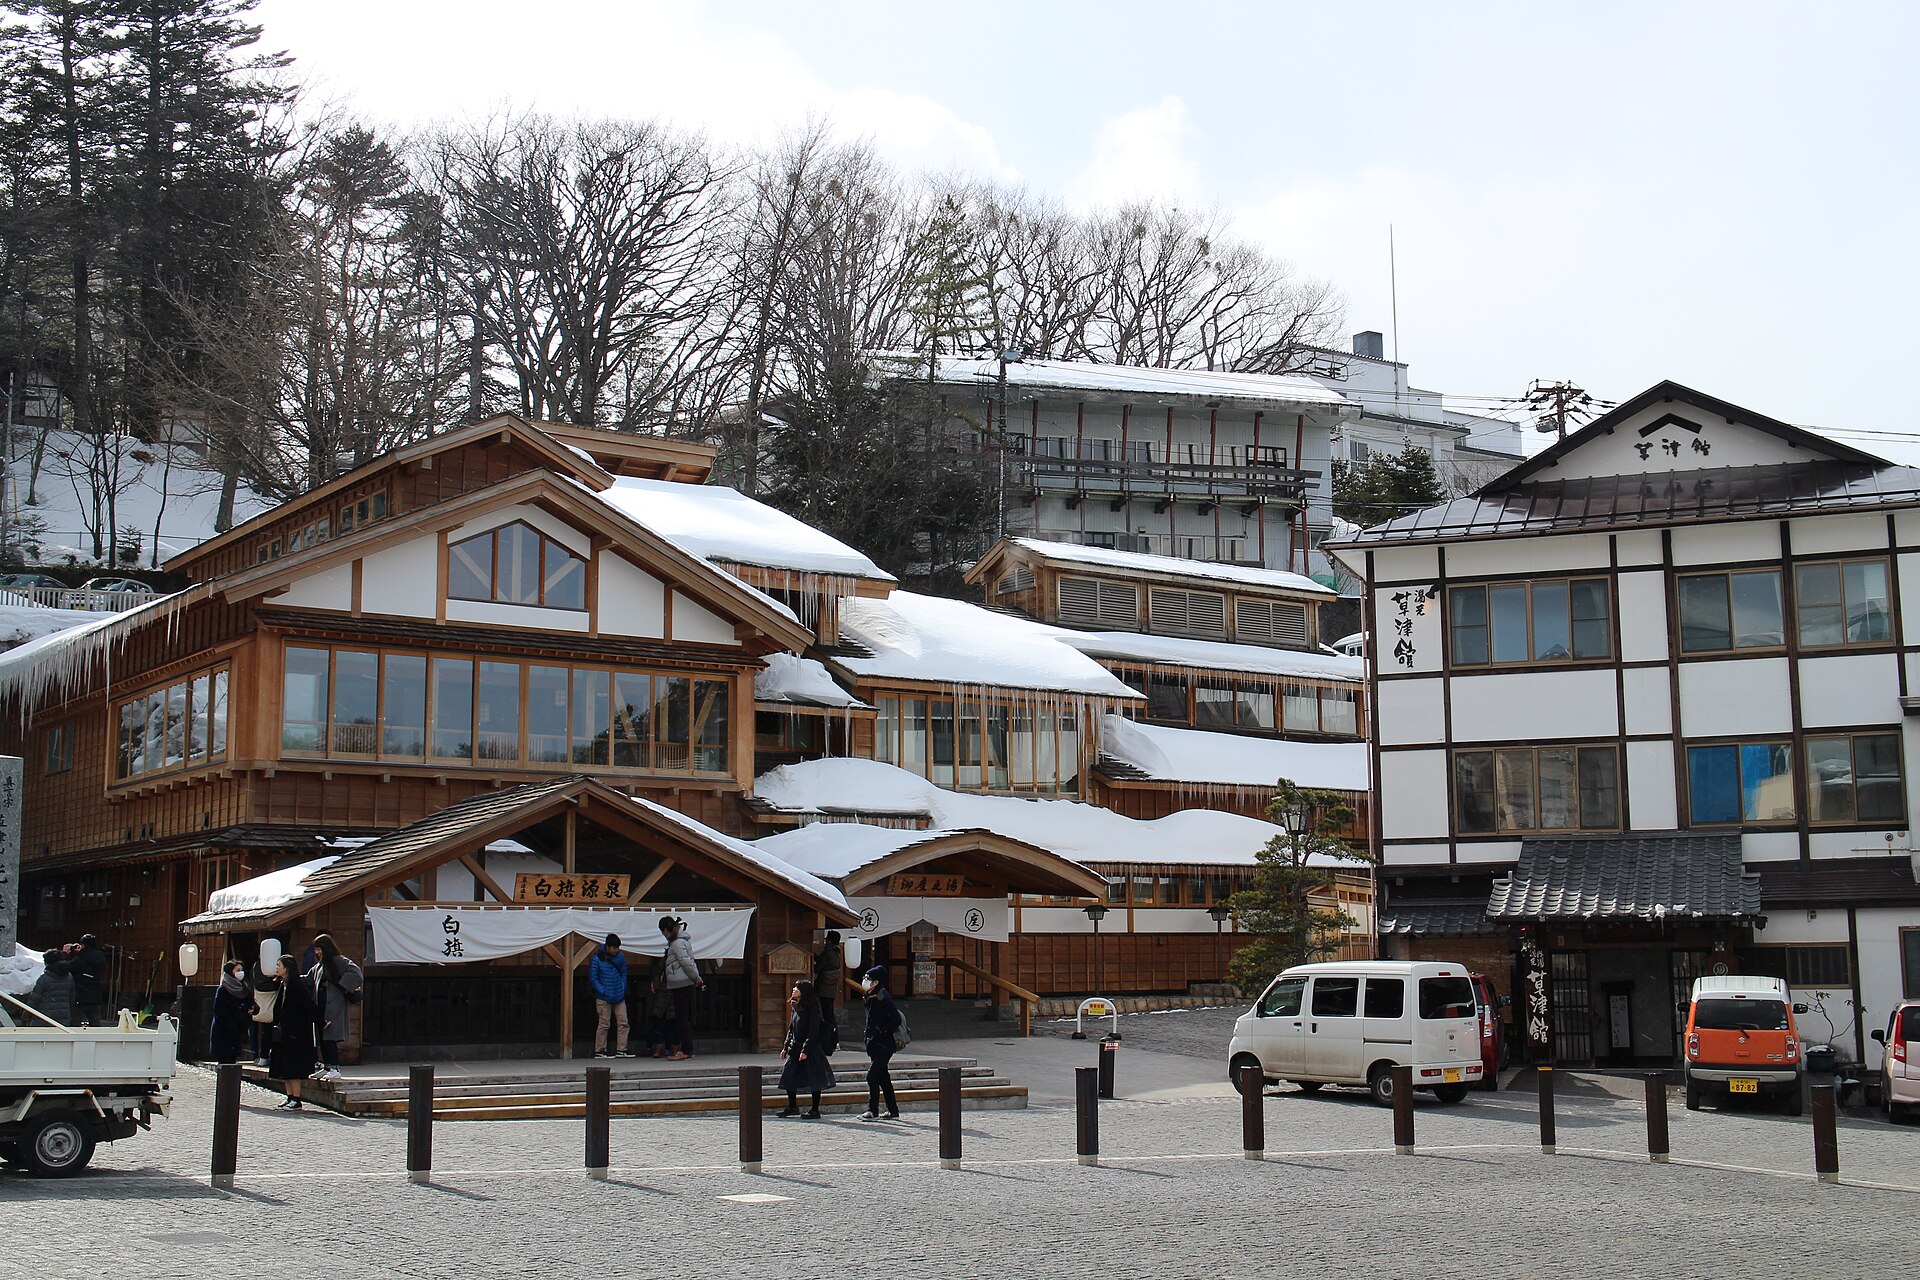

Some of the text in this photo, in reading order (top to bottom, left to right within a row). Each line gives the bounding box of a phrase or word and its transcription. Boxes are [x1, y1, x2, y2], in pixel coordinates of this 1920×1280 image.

[1390, 590, 1417, 668] 草津館
[3, 775, 15, 808] 真言宗
[534, 878, 622, 899] 白旗源泉
[441, 914, 464, 958] 白旗
[1526, 969, 1549, 1044] 草津館
